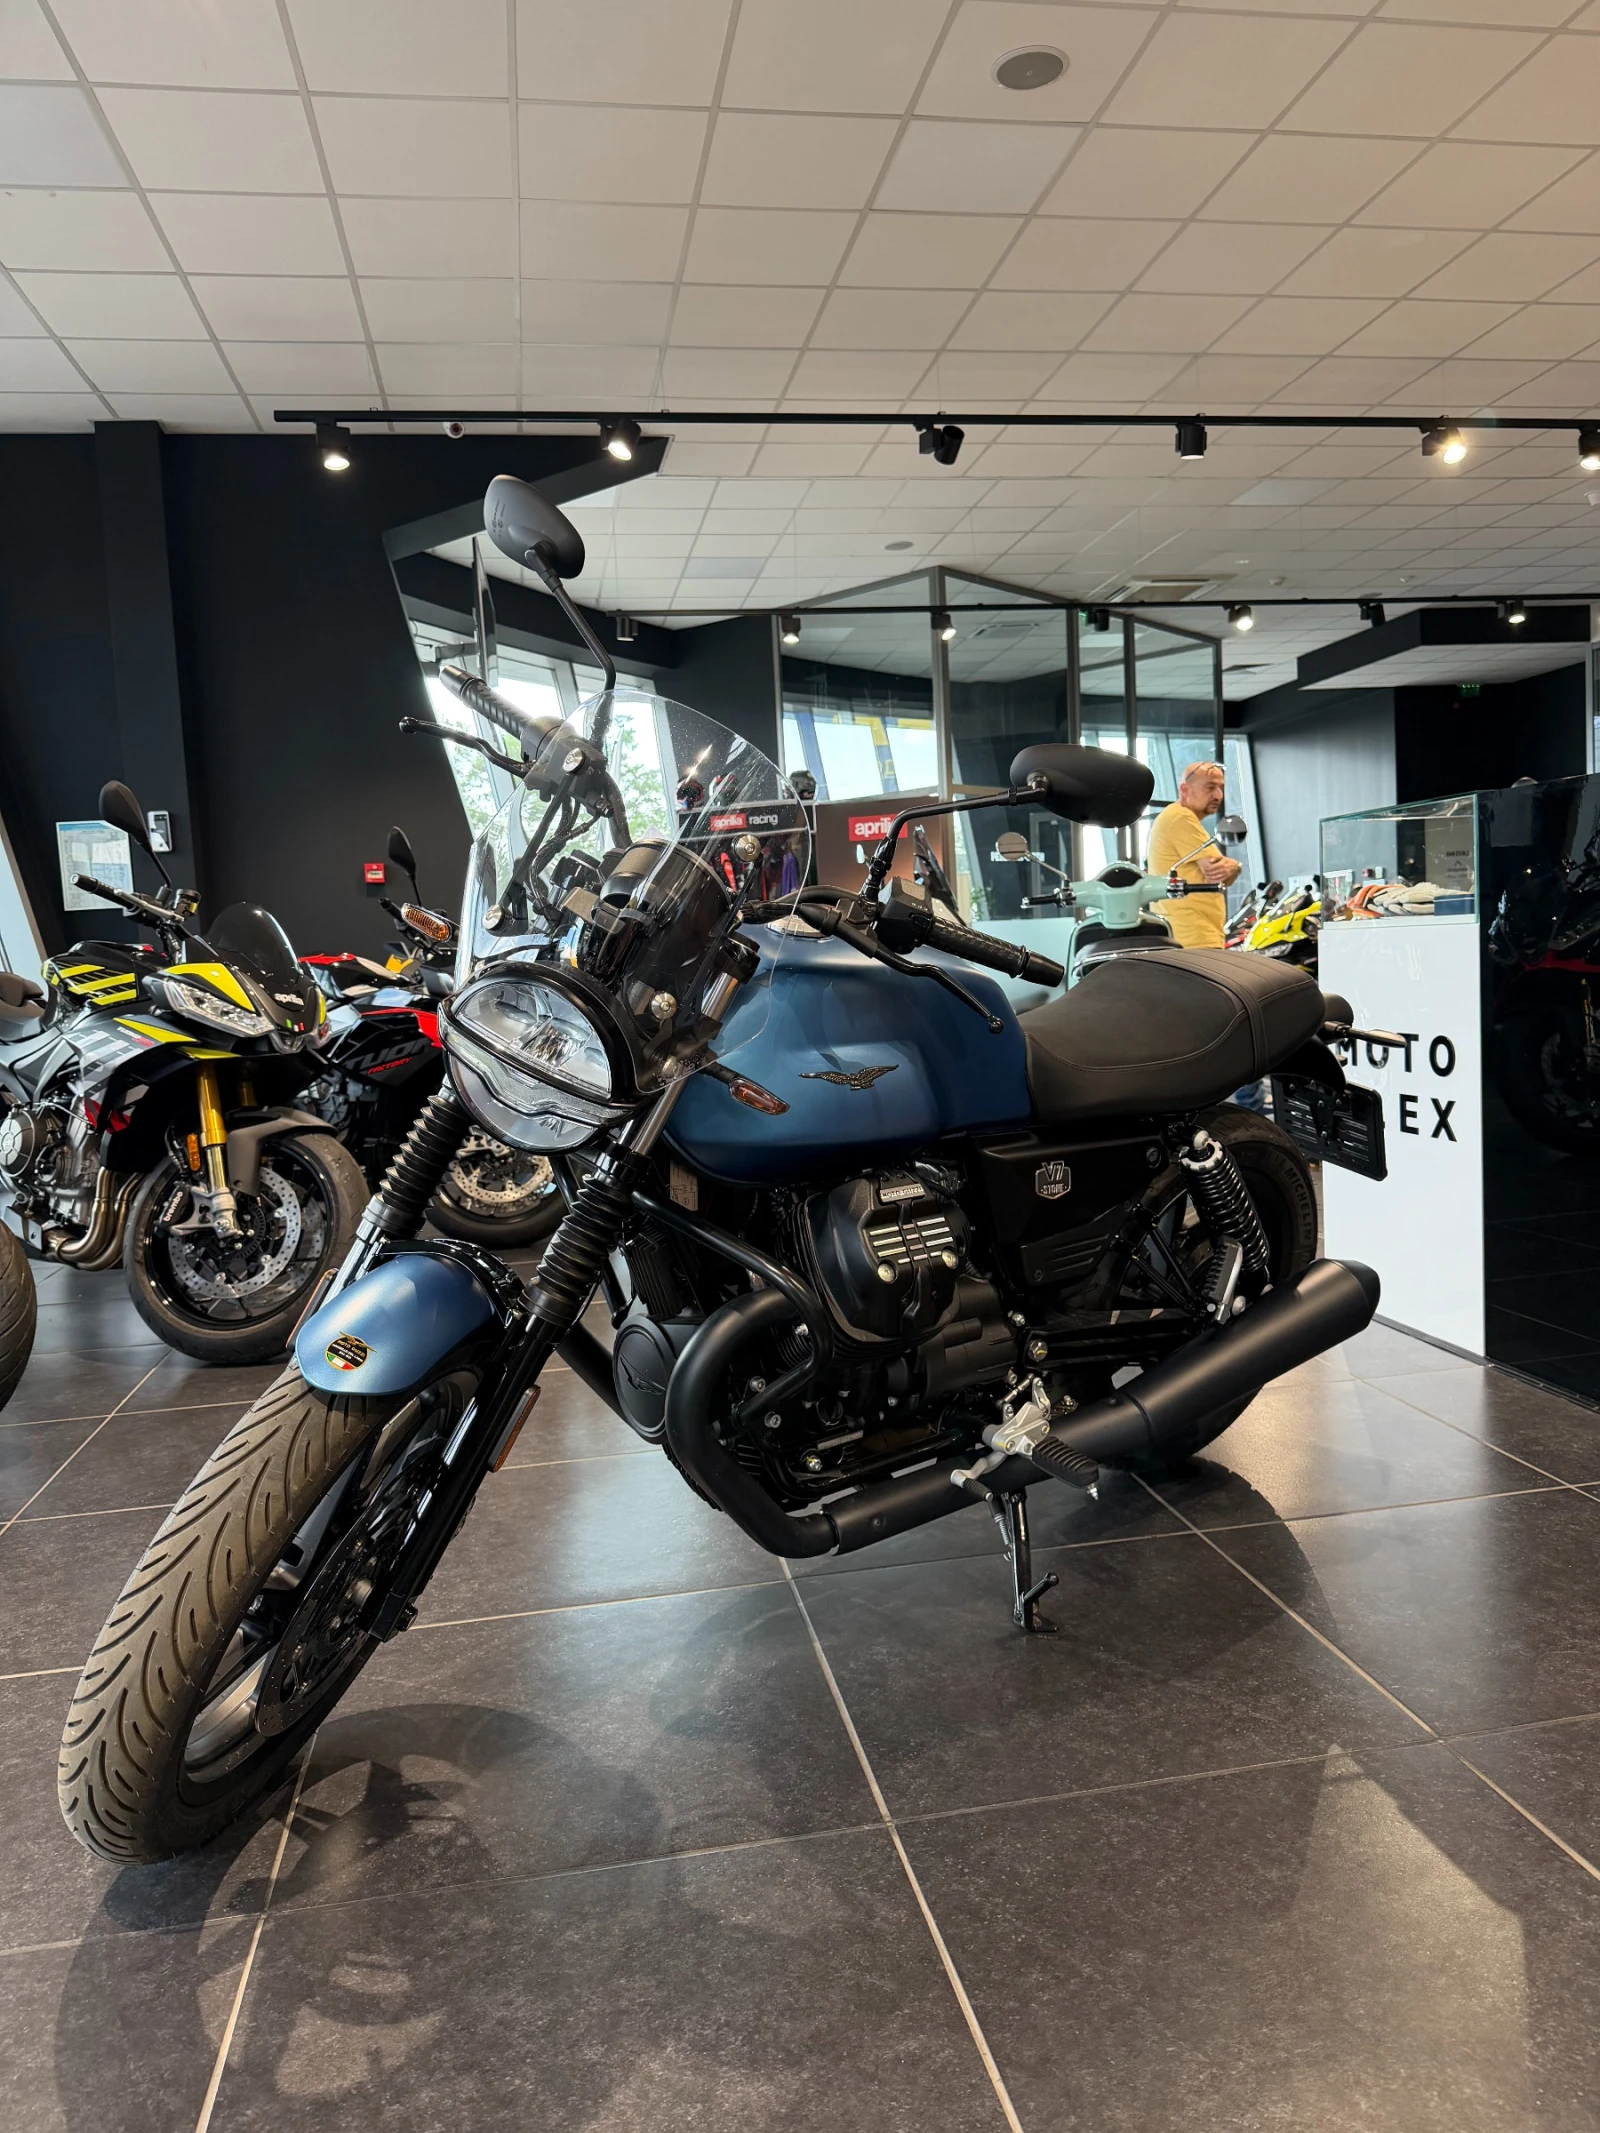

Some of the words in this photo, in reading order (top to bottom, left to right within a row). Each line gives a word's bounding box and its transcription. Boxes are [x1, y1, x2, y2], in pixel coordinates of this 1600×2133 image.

[714, 815, 743, 827] aprilia
[749, 813, 779, 826] racing
[1335, 1032, 1457, 1078] MOTO
[1041, 1160, 1065, 1182] V7
[163, 1192, 183, 1221] brembo
[1284, 1167, 1312, 1240] MICHELIN
